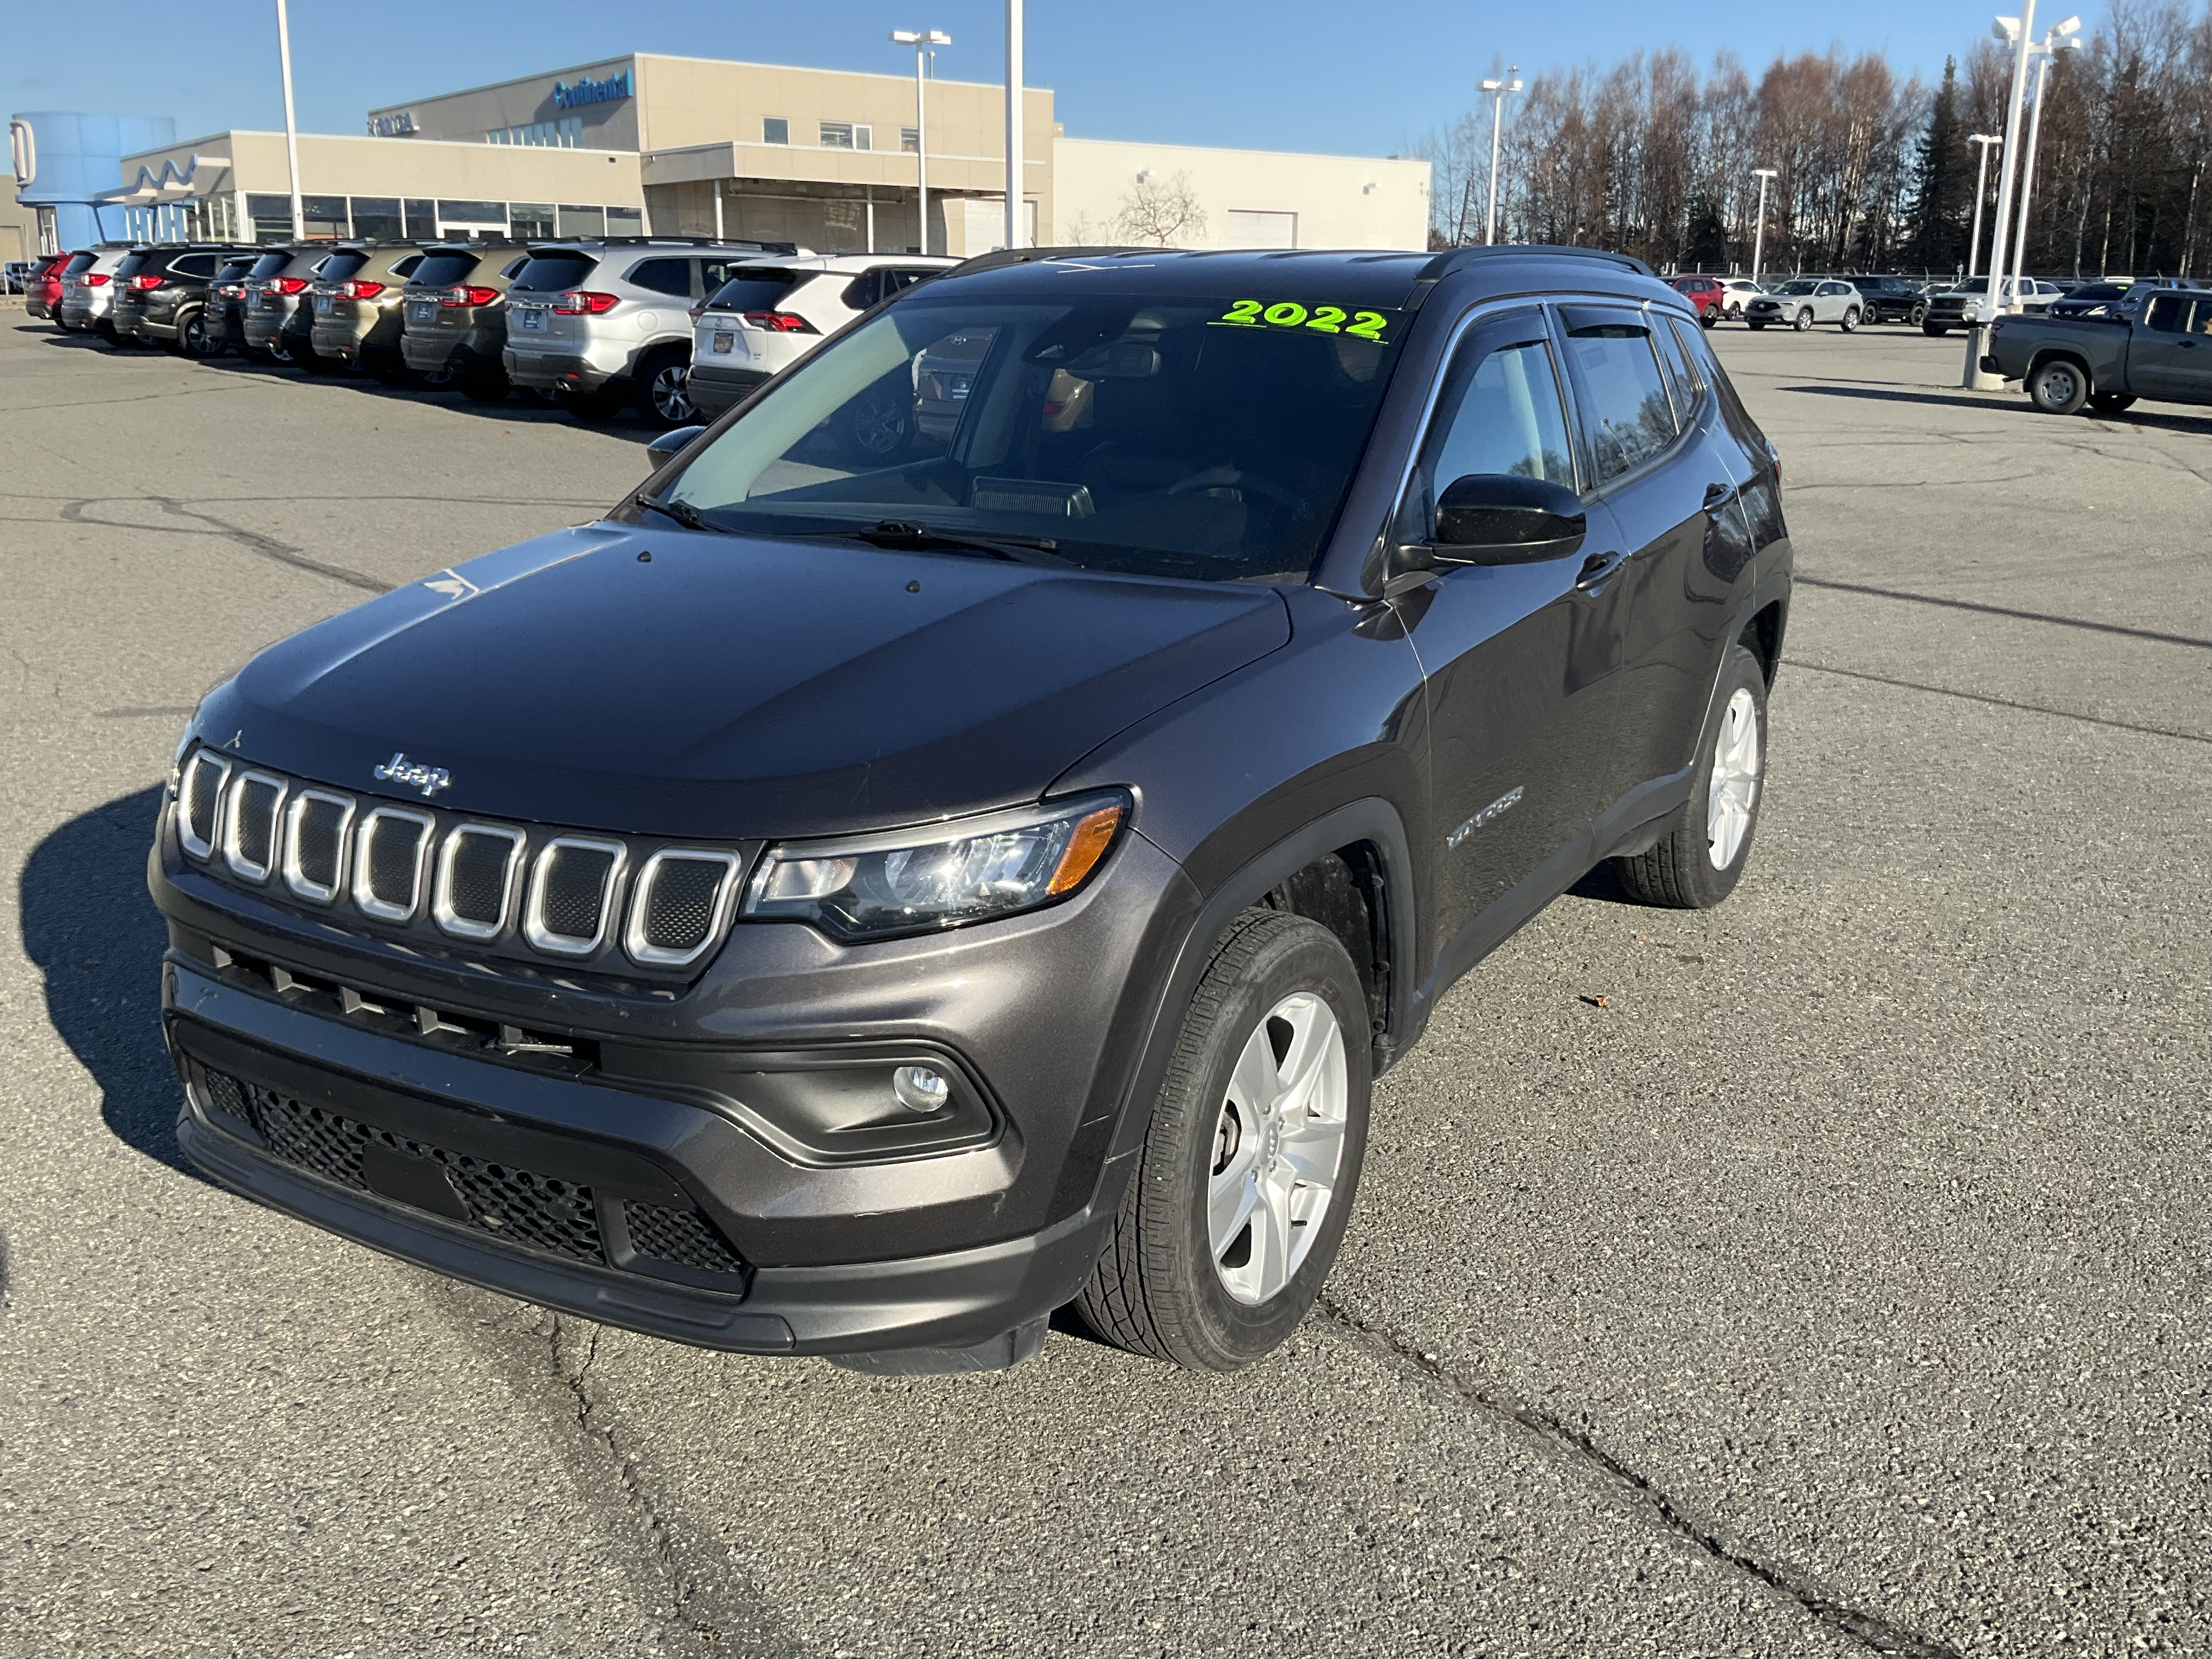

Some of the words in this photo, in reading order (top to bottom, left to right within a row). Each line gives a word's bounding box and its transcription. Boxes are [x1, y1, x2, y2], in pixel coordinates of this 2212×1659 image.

[554, 68, 633, 109] Continental
[1222, 300, 1387, 340] 2022
[374, 752, 450, 796] Jeep
